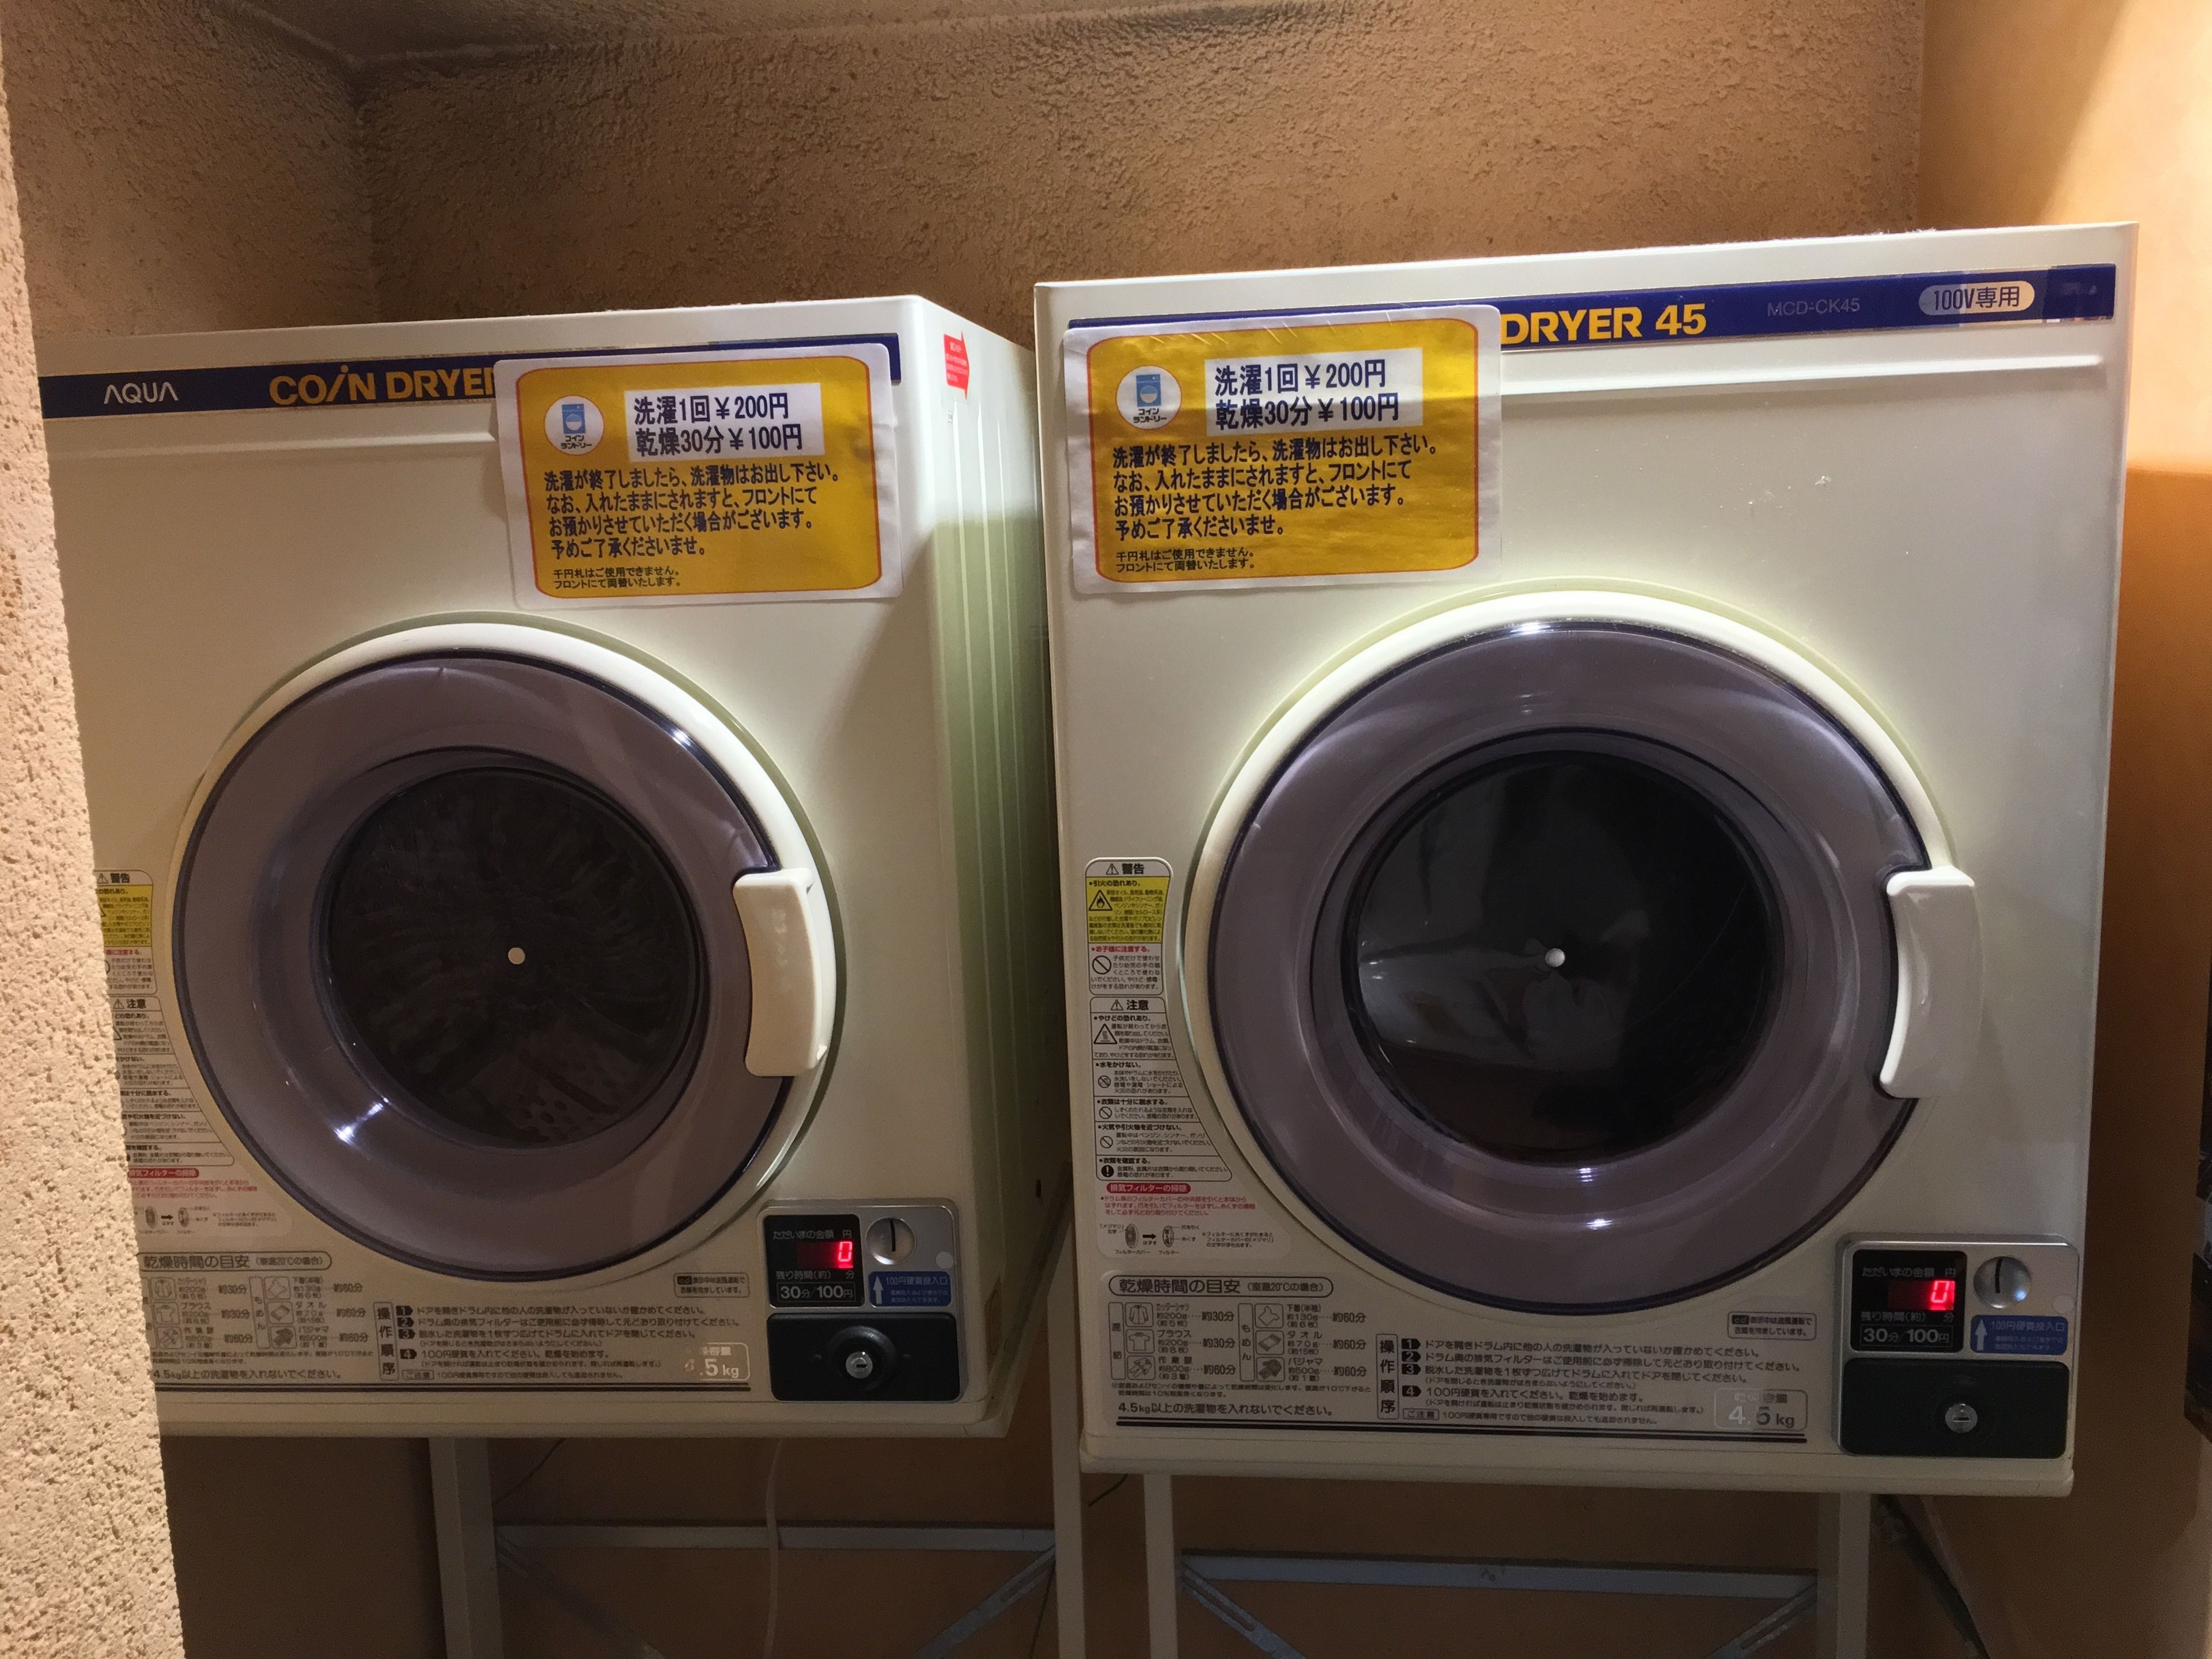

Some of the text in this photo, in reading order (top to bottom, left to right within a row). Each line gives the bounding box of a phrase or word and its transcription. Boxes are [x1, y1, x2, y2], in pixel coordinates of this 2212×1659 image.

[1767, 297, 1861, 317] MCD-CK45
[1933, 286, 2021, 311] 100V専用
[1501, 304, 1707, 344] DRYER 45
[270, 364, 376, 406] COIN
[1215, 359, 1387, 396] 洗濯1回¥200円
[103, 382, 178, 405] AQUA
[634, 392, 789, 425] 洗濯1回¥200円
[1138, 408, 1160, 417] コイン
[1215, 392, 1399, 430] 乾燥30分¥100円
[636, 424, 803, 457] 乾燥30分¥100円
[1115, 518, 1284, 541] 予めご了承くださいませ。
[551, 537, 705, 559] 予めご了承くださいませ。
[1122, 863, 1145, 874] 警告
[127, 999, 146, 1008] 注意
[1127, 999, 1149, 1010] 注意
[838, 1241, 853, 1262] 0
[1119, 1279, 1241, 1293] 乾燥時間の目安
[1931, 1281, 1949, 1303] 0
